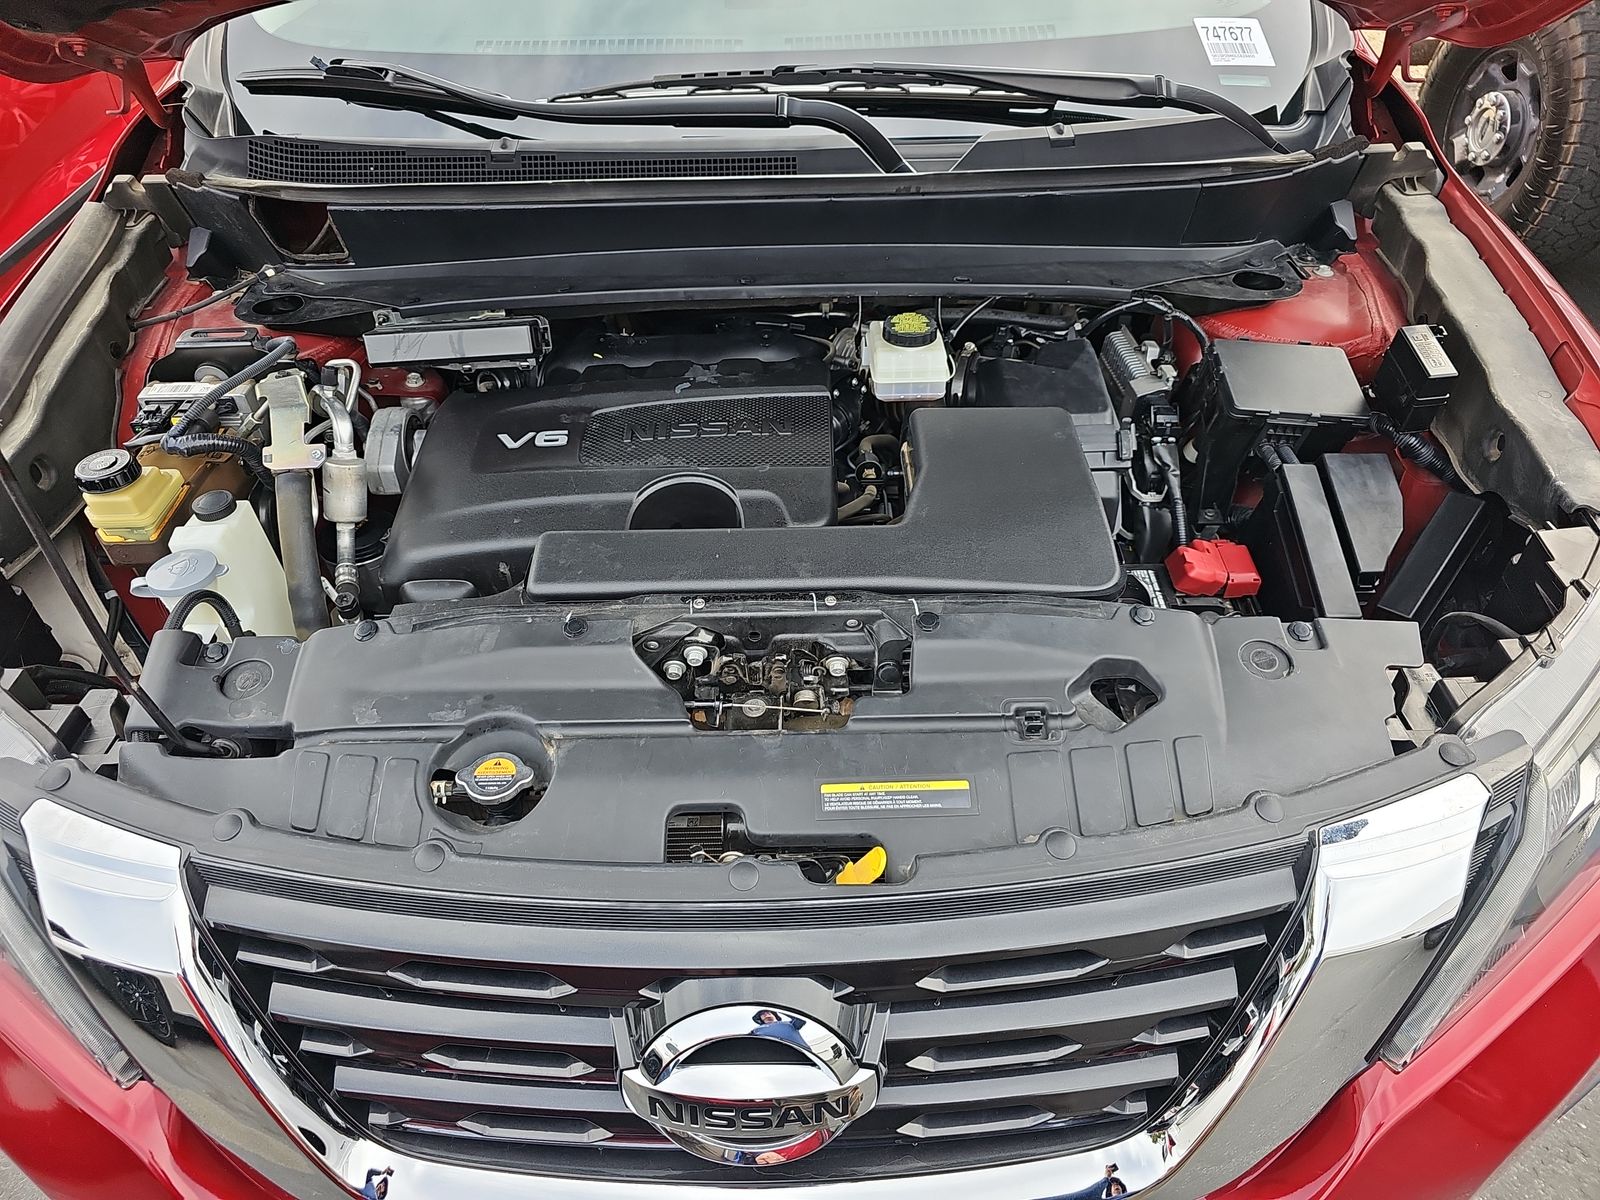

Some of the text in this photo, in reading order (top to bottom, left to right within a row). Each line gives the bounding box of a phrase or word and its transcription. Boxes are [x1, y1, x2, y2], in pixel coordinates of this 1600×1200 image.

[1200, 26, 1252, 42] 747677
[496, 429, 569, 450] V6
[623, 416, 794, 443] NISSAN
[648, 1094, 849, 1131] NISSAN
